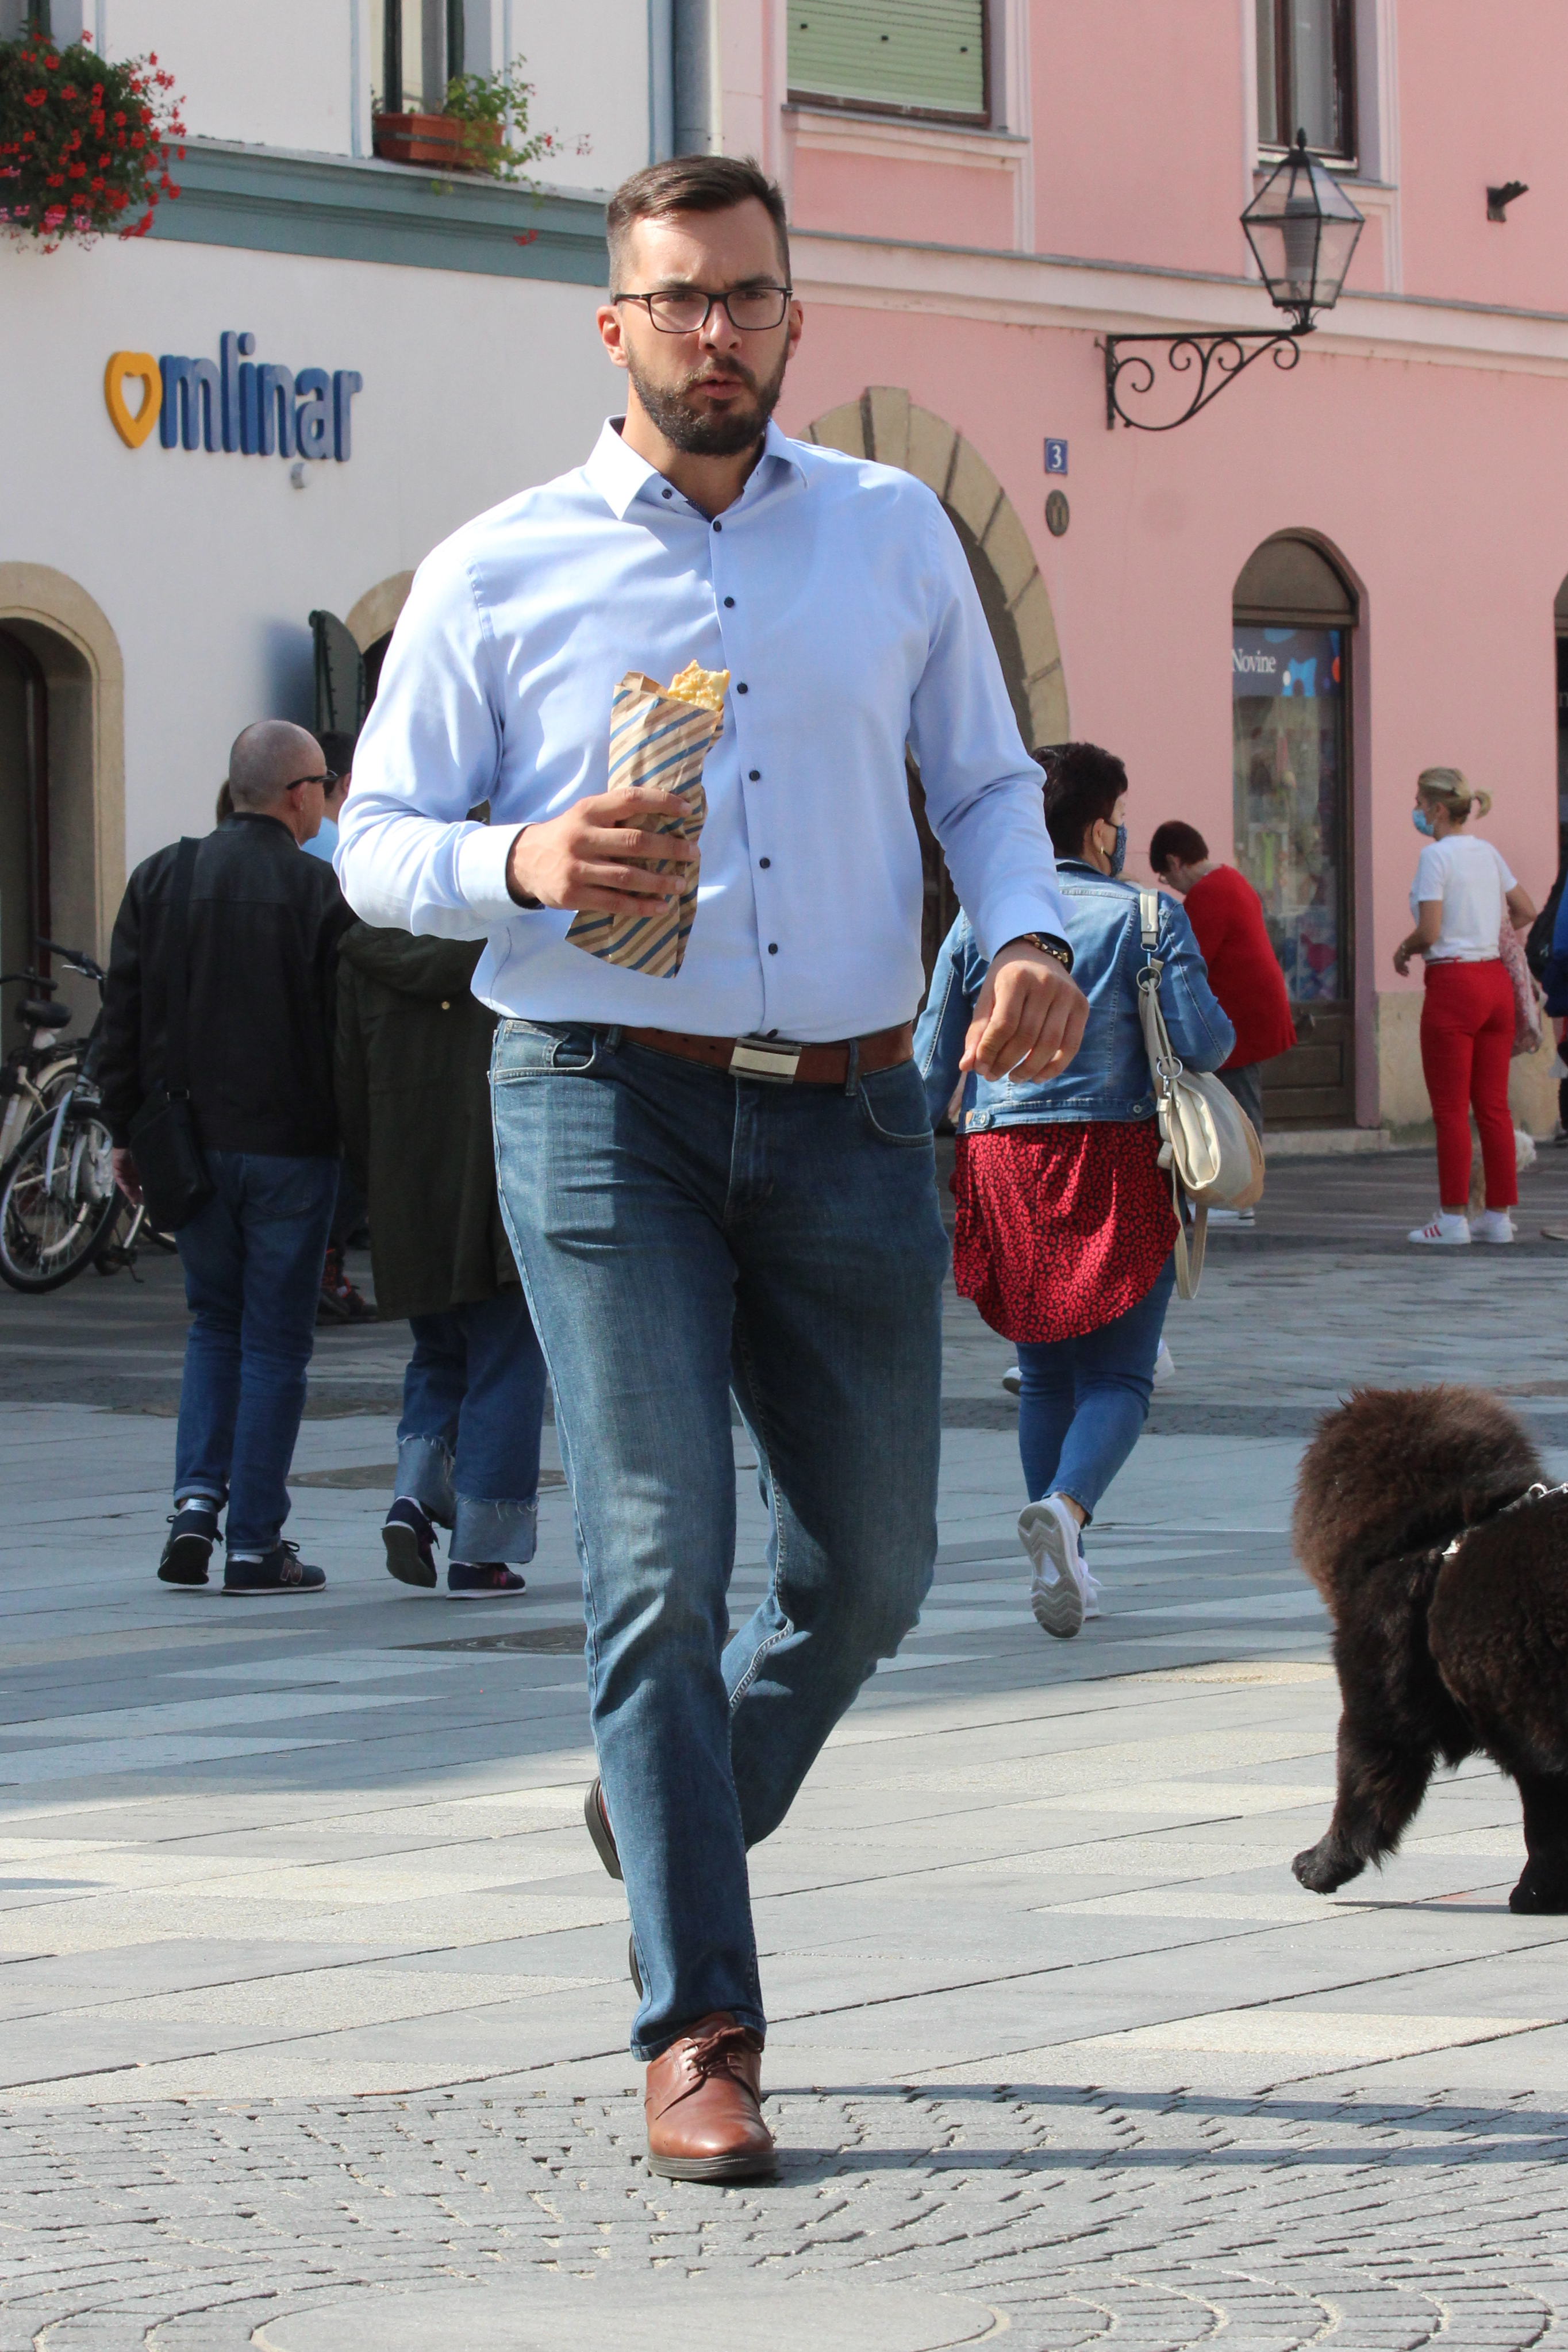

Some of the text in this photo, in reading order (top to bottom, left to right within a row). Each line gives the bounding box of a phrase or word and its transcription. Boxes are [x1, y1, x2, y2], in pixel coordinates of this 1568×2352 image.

[159, 330, 363, 462] mlinar
[1052, 444, 1062, 468] 3
[1232, 648, 1277, 673] Novine
